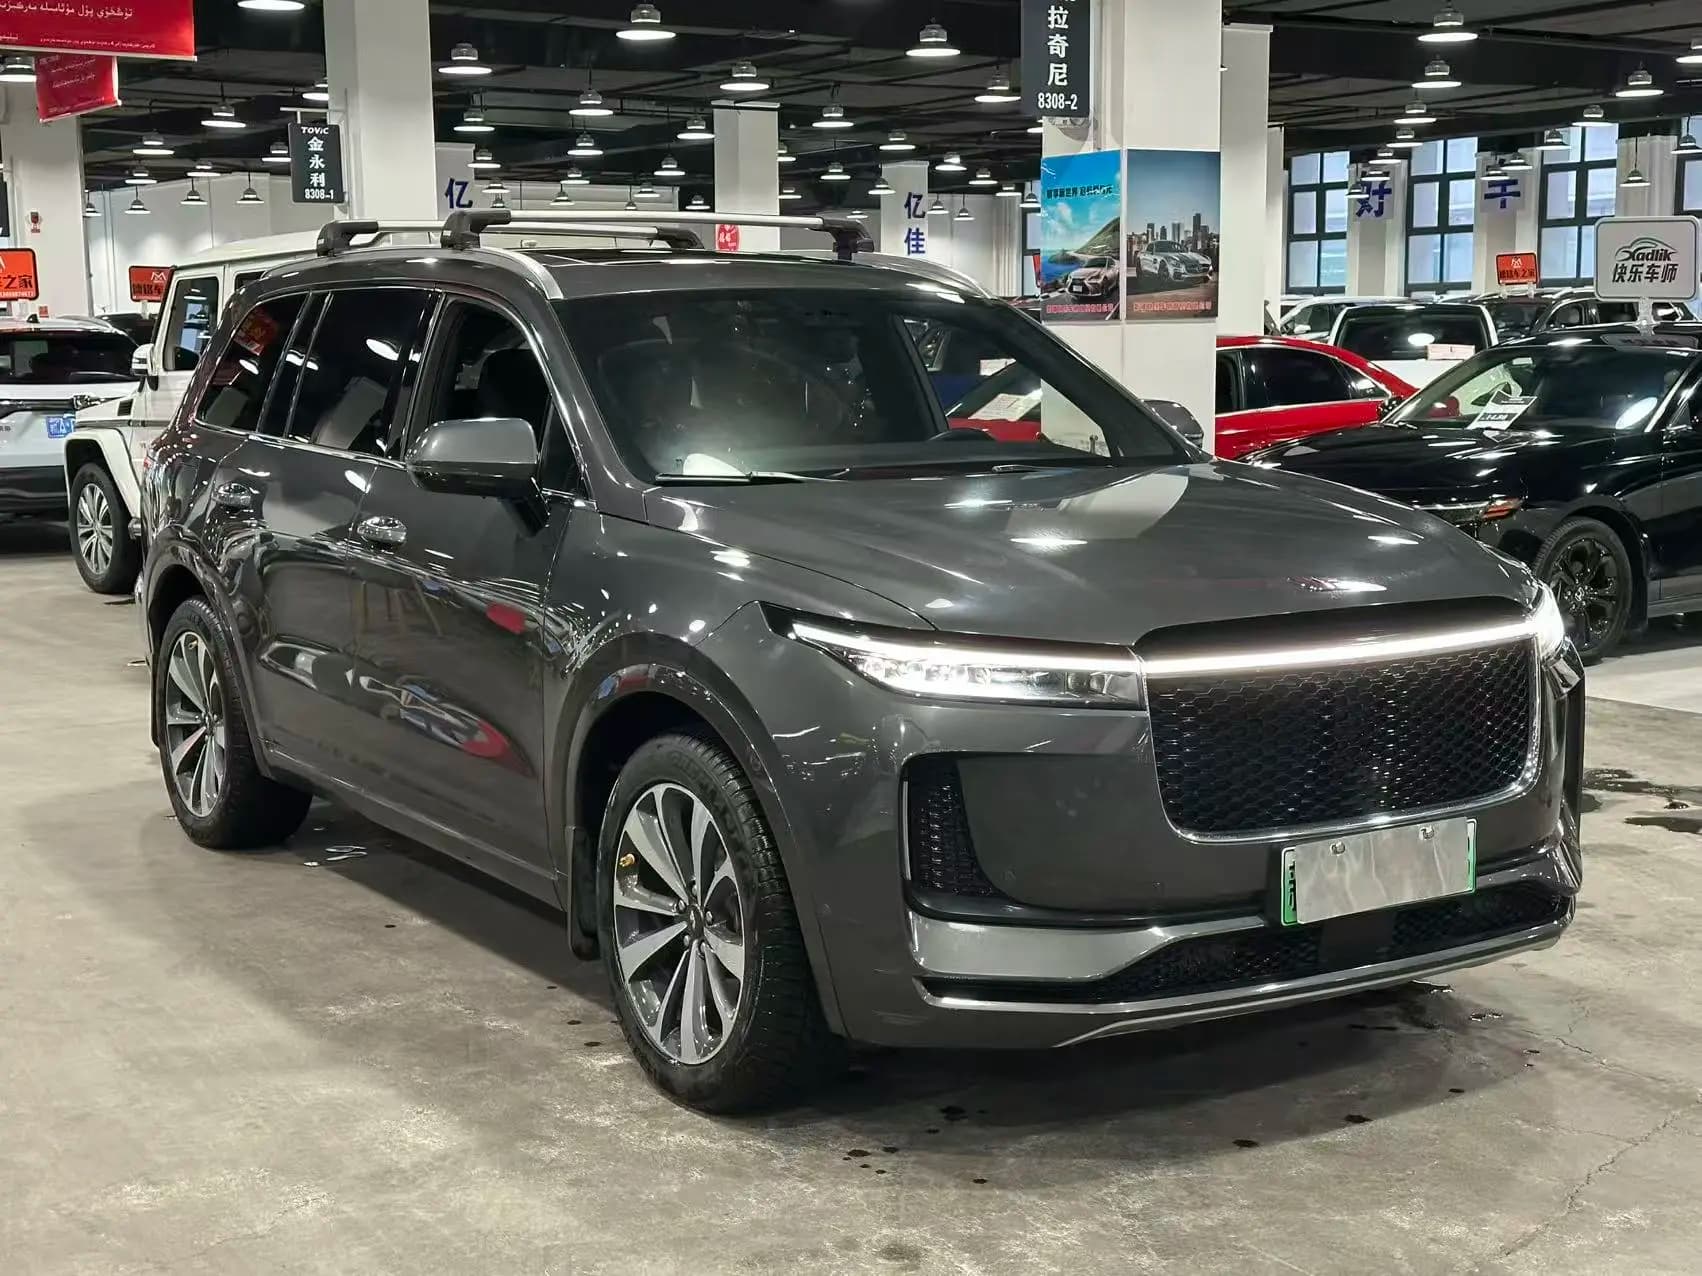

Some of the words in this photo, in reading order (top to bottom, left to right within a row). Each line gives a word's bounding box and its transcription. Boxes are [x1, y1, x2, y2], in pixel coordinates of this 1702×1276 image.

[1047, 0, 1069, 86] 拉奇尼
[1038, 93, 1078, 110] 8308-2
[307, 136, 326, 187] 金永利
[304, 188, 334, 199] 8308-1
[444, 177, 474, 208] 亿
[904, 191, 926, 256] 亿佳
[0, 274, 33, 289] 之家
[1612, 263, 1679, 283] 快乐车师
